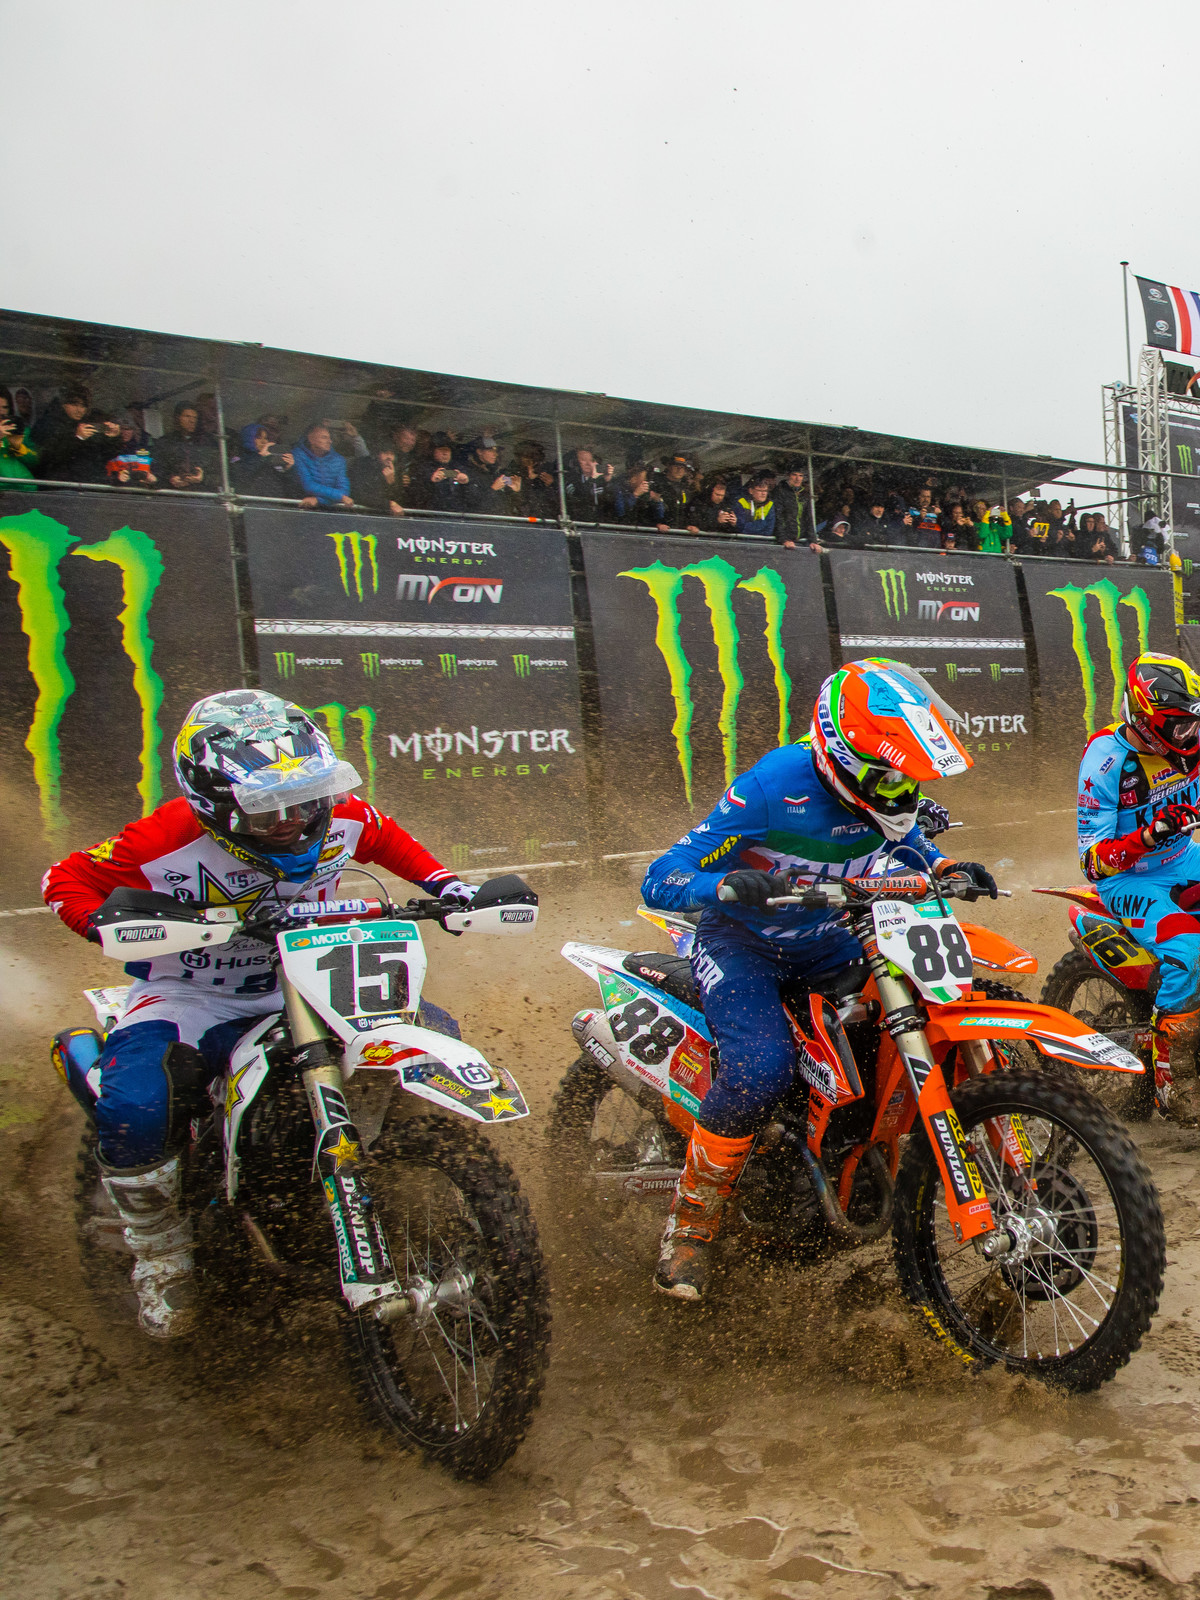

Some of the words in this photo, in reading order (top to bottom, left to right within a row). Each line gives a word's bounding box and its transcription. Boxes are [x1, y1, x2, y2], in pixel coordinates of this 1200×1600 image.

[397, 536, 497, 557] MONSTER
[414, 556, 484, 565] ENERGY
[916, 571, 975, 586] MONSTER
[296, 657, 344, 666] MONSTER
[380, 658, 424, 667] MONSTER
[457, 659, 498, 667] MONSTER
[530, 659, 569, 667] MONSTER
[388, 725, 576, 762] MONSTER
[876, 740, 906, 768] ITALIA
[423, 763, 551, 780] ENERGY
[787, 806, 806, 814] ITALIA
[118, 926, 165, 941] PROTAPER
[906, 923, 973, 982] 88
[317, 942, 409, 1017] 15
[639, 966, 667, 981] GUTS
[978, 1018, 1029, 1028] MOTOREX
[609, 997, 686, 1065] 88
[365, 1046, 394, 1060] FMF
[584, 1037, 617, 1068] HGS
[935, 1118, 971, 1198] DUNLOP
[330, 1202, 351, 1279] MOTOREX
